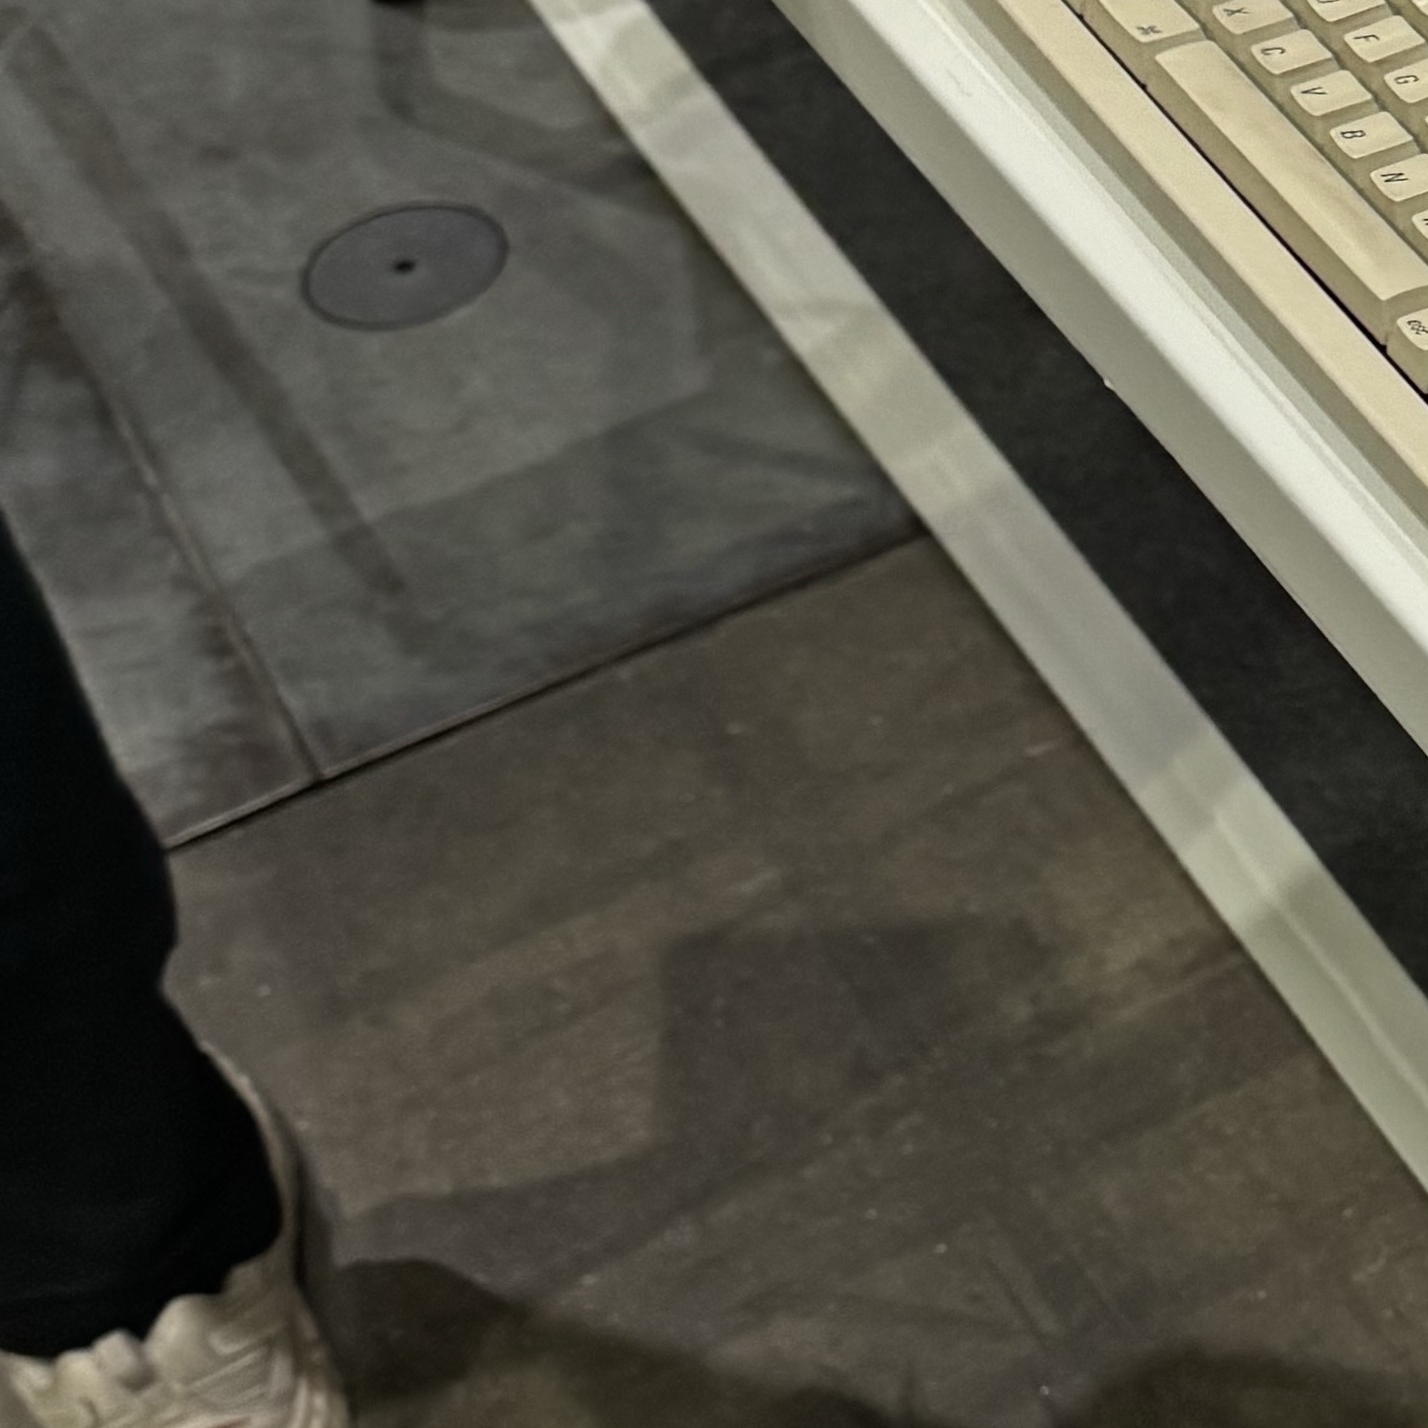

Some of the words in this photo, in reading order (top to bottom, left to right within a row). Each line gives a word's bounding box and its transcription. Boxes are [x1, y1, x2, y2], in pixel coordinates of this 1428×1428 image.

[1223, 7, 1249, 17] X
[1353, 34, 1380, 42] F
[1260, 46, 1286, 56] C
[1393, 74, 1420, 85] G
[1300, 86, 1328, 96] V
[1339, 129, 1367, 140] B
[1380, 172, 1409, 183] N
